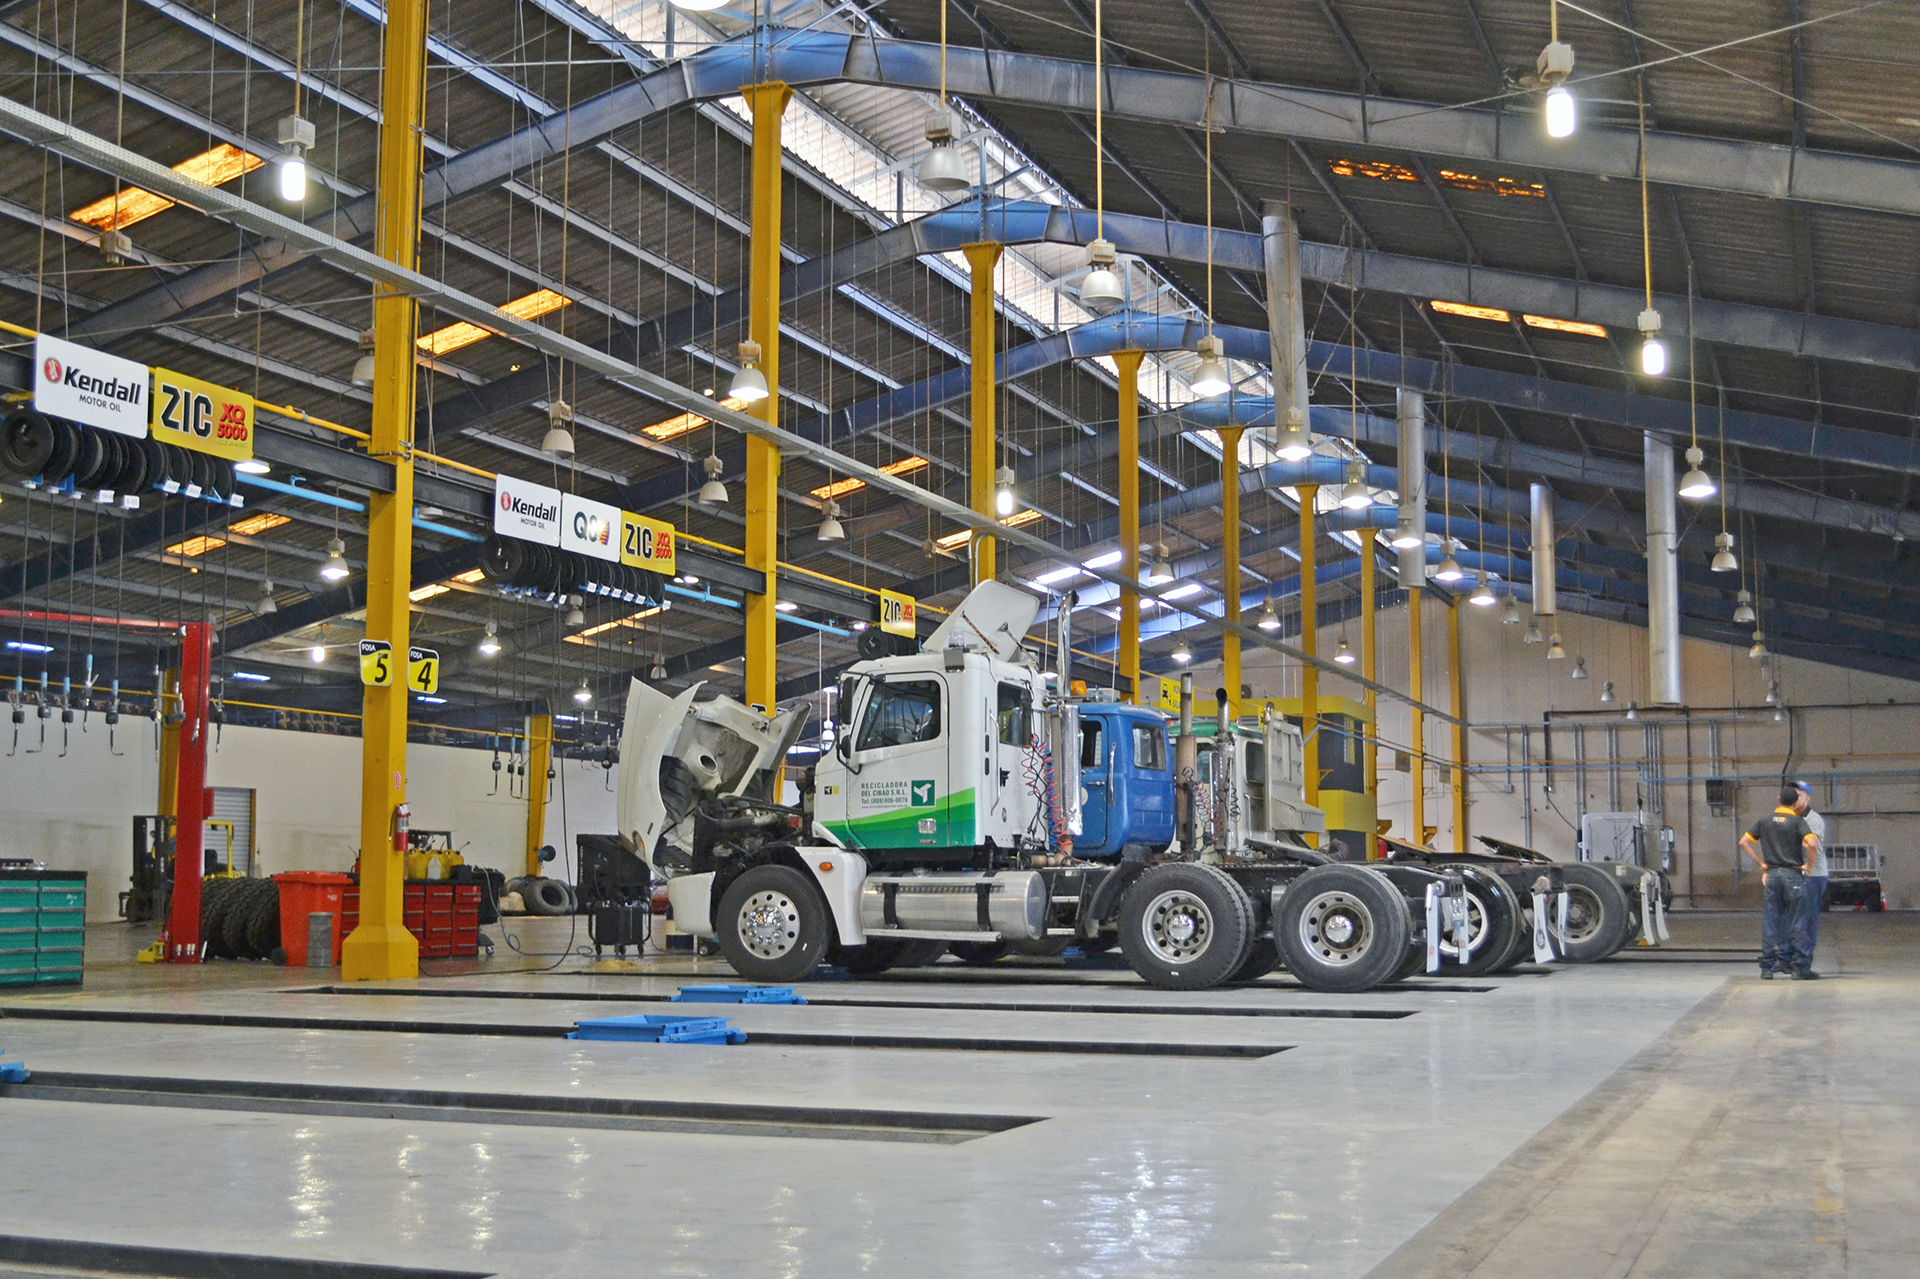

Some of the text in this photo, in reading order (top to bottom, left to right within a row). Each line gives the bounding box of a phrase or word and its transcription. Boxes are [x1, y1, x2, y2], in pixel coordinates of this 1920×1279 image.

[64, 366, 142, 405] Kendall
[79, 394, 122, 413] MOTOR OIL
[160, 382, 213, 439] ZIC
[220, 402, 246, 426] XQ
[217, 422, 248, 441] 5000
[512, 496, 557, 522] Kendall
[520, 517, 546, 530] MOTOR OIL
[624, 522, 653, 559] ZIC
[656, 531, 671, 547] XQ
[655, 546, 672, 559] 5000
[883, 598, 901, 624] ZIC
[410, 650, 423, 659] FOSA
[375, 654, 388, 683] 5
[418, 662, 431, 691] 4
[872, 789, 890, 797] CIBAO
